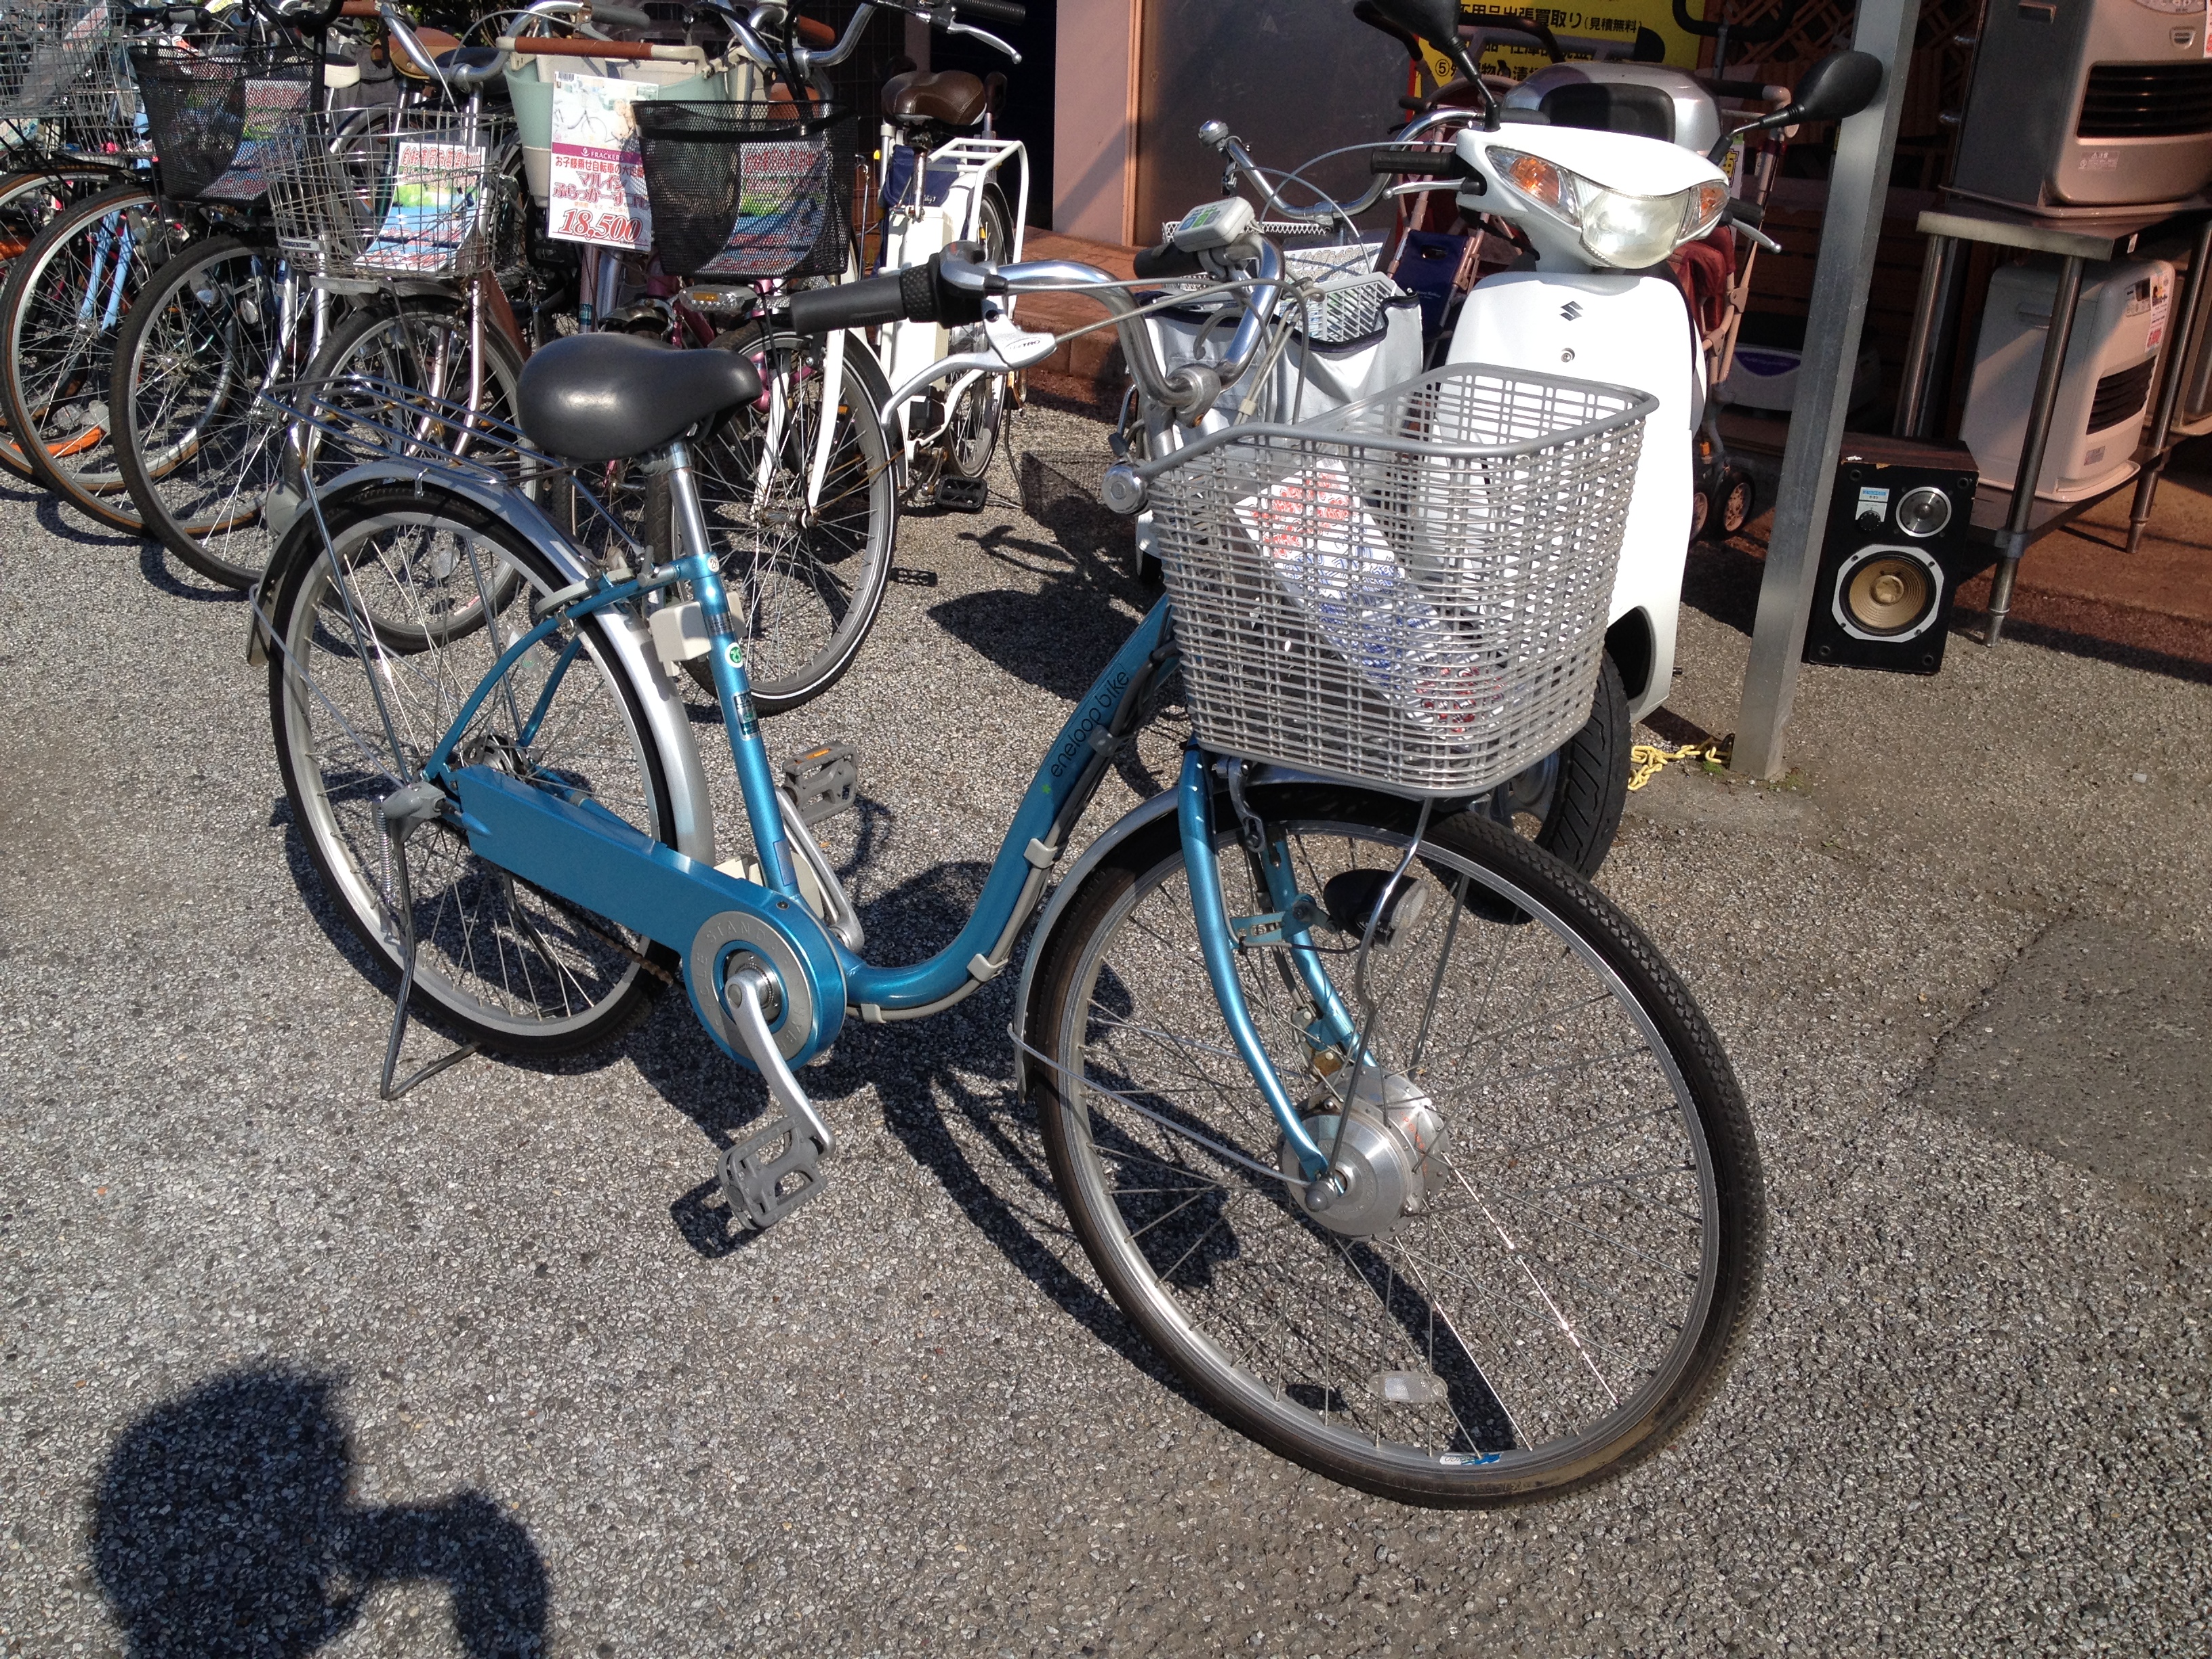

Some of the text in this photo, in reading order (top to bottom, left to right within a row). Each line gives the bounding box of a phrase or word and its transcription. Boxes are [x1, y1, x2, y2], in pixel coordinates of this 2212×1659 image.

[558, 209, 642, 242] 18,500
[1051, 672, 1129, 777] eneloop bike
